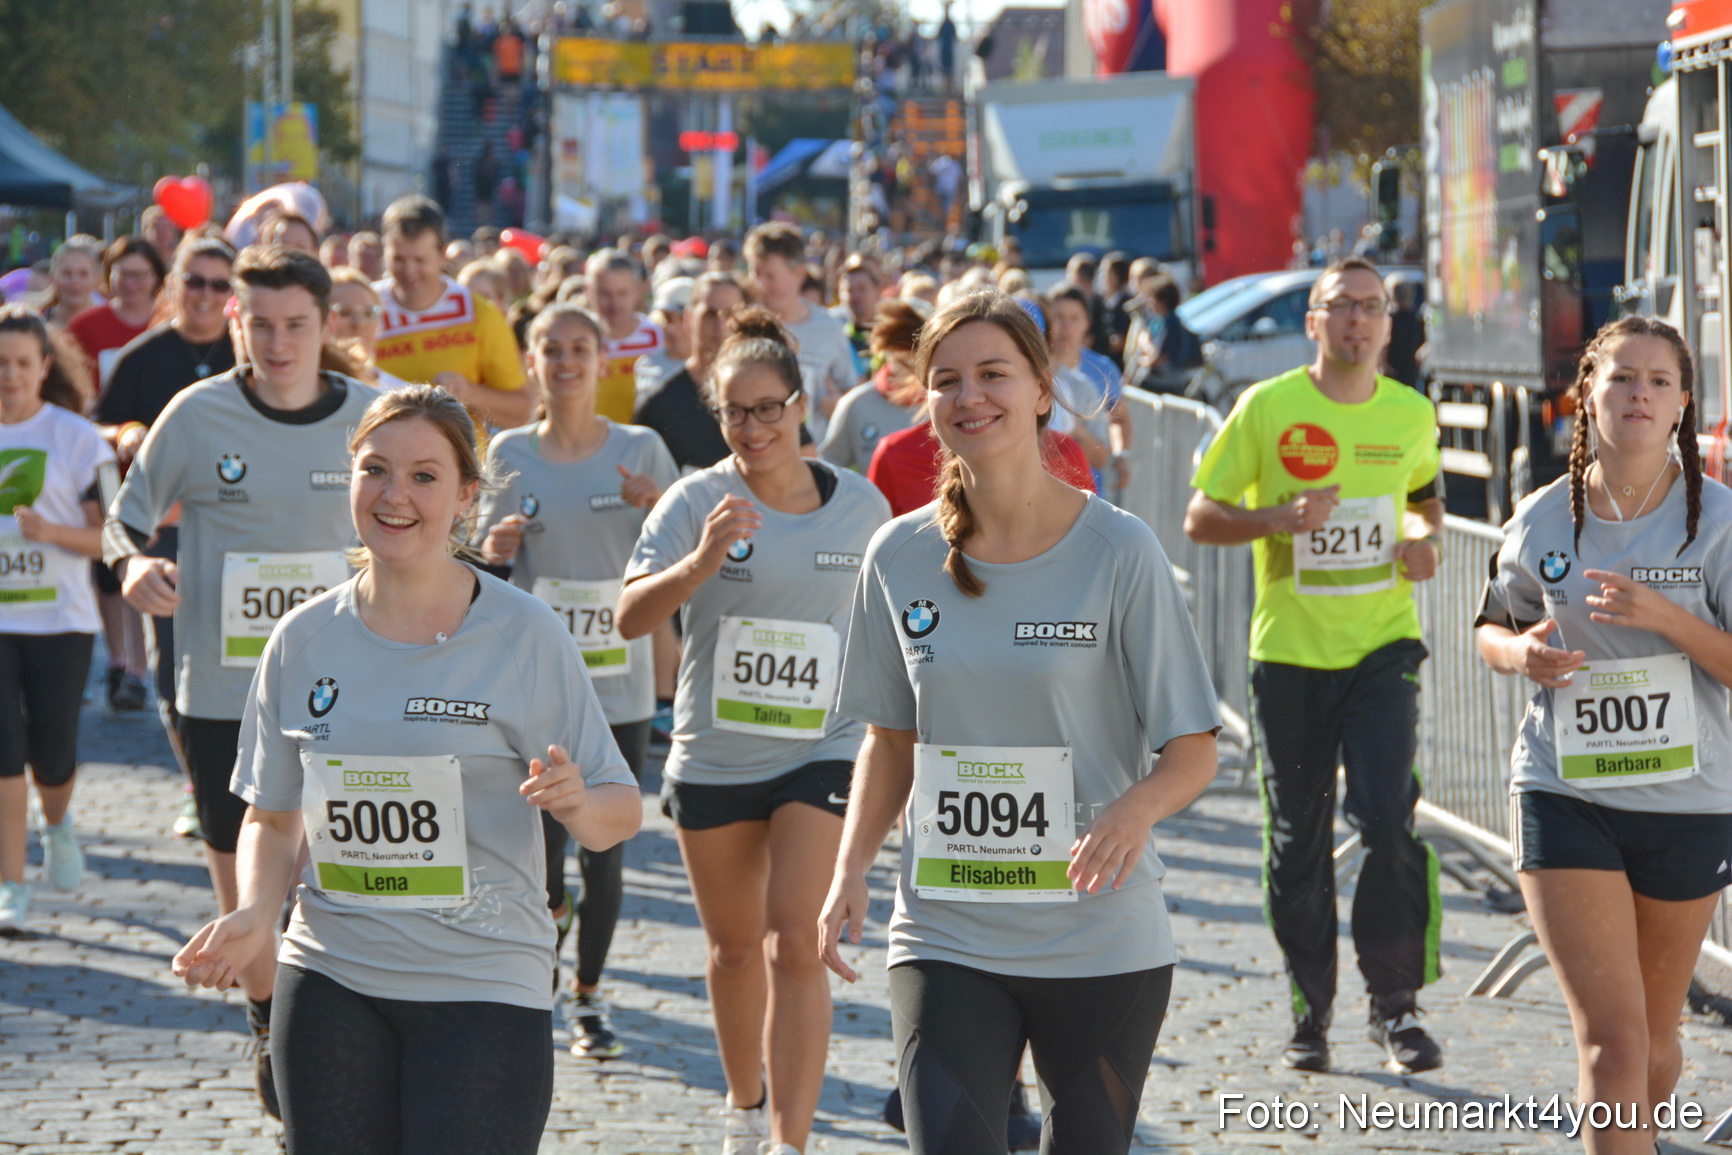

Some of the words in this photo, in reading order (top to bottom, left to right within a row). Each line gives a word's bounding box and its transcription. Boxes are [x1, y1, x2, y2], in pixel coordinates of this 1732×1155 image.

[310, 471, 352, 485] BOC
[1311, 524, 1383, 555] 5214
[1631, 567, 1702, 583] BOCK
[242, 587, 329, 619] 506
[1015, 621, 1099, 641] BOCK
[1040, 640, 1049, 648] by
[734, 651, 819, 690] 5044
[1591, 669, 1650, 687] BOCK
[405, 697, 491, 720] BOCK
[752, 706, 792, 724] Talita
[1575, 692, 1671, 735] 5007
[402, 715, 428, 723] inspired
[1586, 740, 1614, 749] PARTL
[1616, 738, 1657, 747] Neumarkt
[957, 761, 1025, 779] BOCK
[1595, 756, 1662, 774] Barbara
[343, 770, 412, 788] BOCK
[326, 800, 440, 845] 5008
[937, 790, 1049, 838] 5094
[316, 832, 322, 841] S
[923, 825, 929, 834] S
[341, 850, 370, 861] PARTL
[372, 852, 419, 861] Neumarkt
[947, 843, 978, 853] PARTL
[979, 845, 1027, 855] Neumarkt
[363, 871, 409, 891] Lena
[950, 864, 1037, 885] Elisabeth
